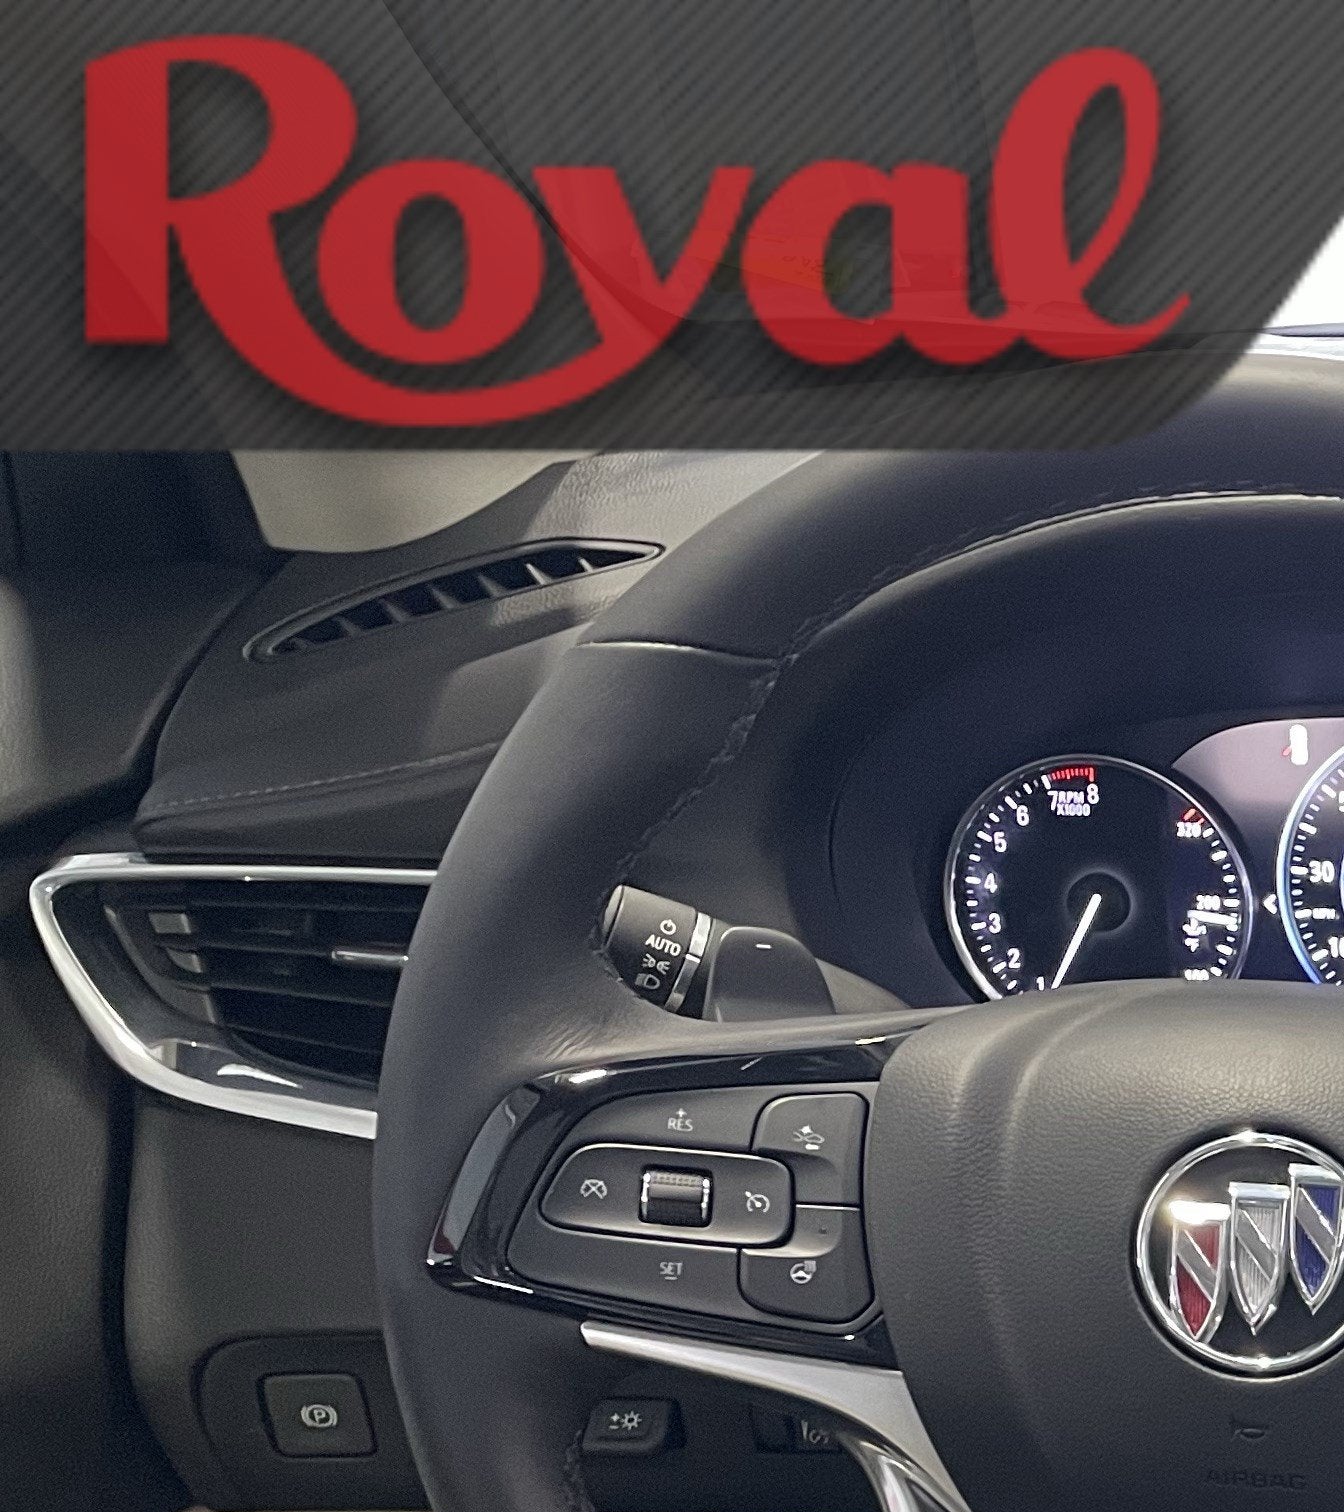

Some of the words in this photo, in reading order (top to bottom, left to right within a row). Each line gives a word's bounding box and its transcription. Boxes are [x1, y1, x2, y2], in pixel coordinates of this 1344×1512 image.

[1047, 790, 1058, 810] 7
[1086, 783, 1099, 804] 8
[1016, 806, 1029, 826] 6
[993, 832, 1007, 852] 5
[1309, 861, 1335, 882] 30
[984, 872, 998, 893] 4
[988, 914, 1001, 933] 3
[645, 934, 681, 956] AUTO
[1007, 948, 1020, 968] 2
[667, 1117, 693, 1132] RES
[660, 1262, 683, 1276] SET
